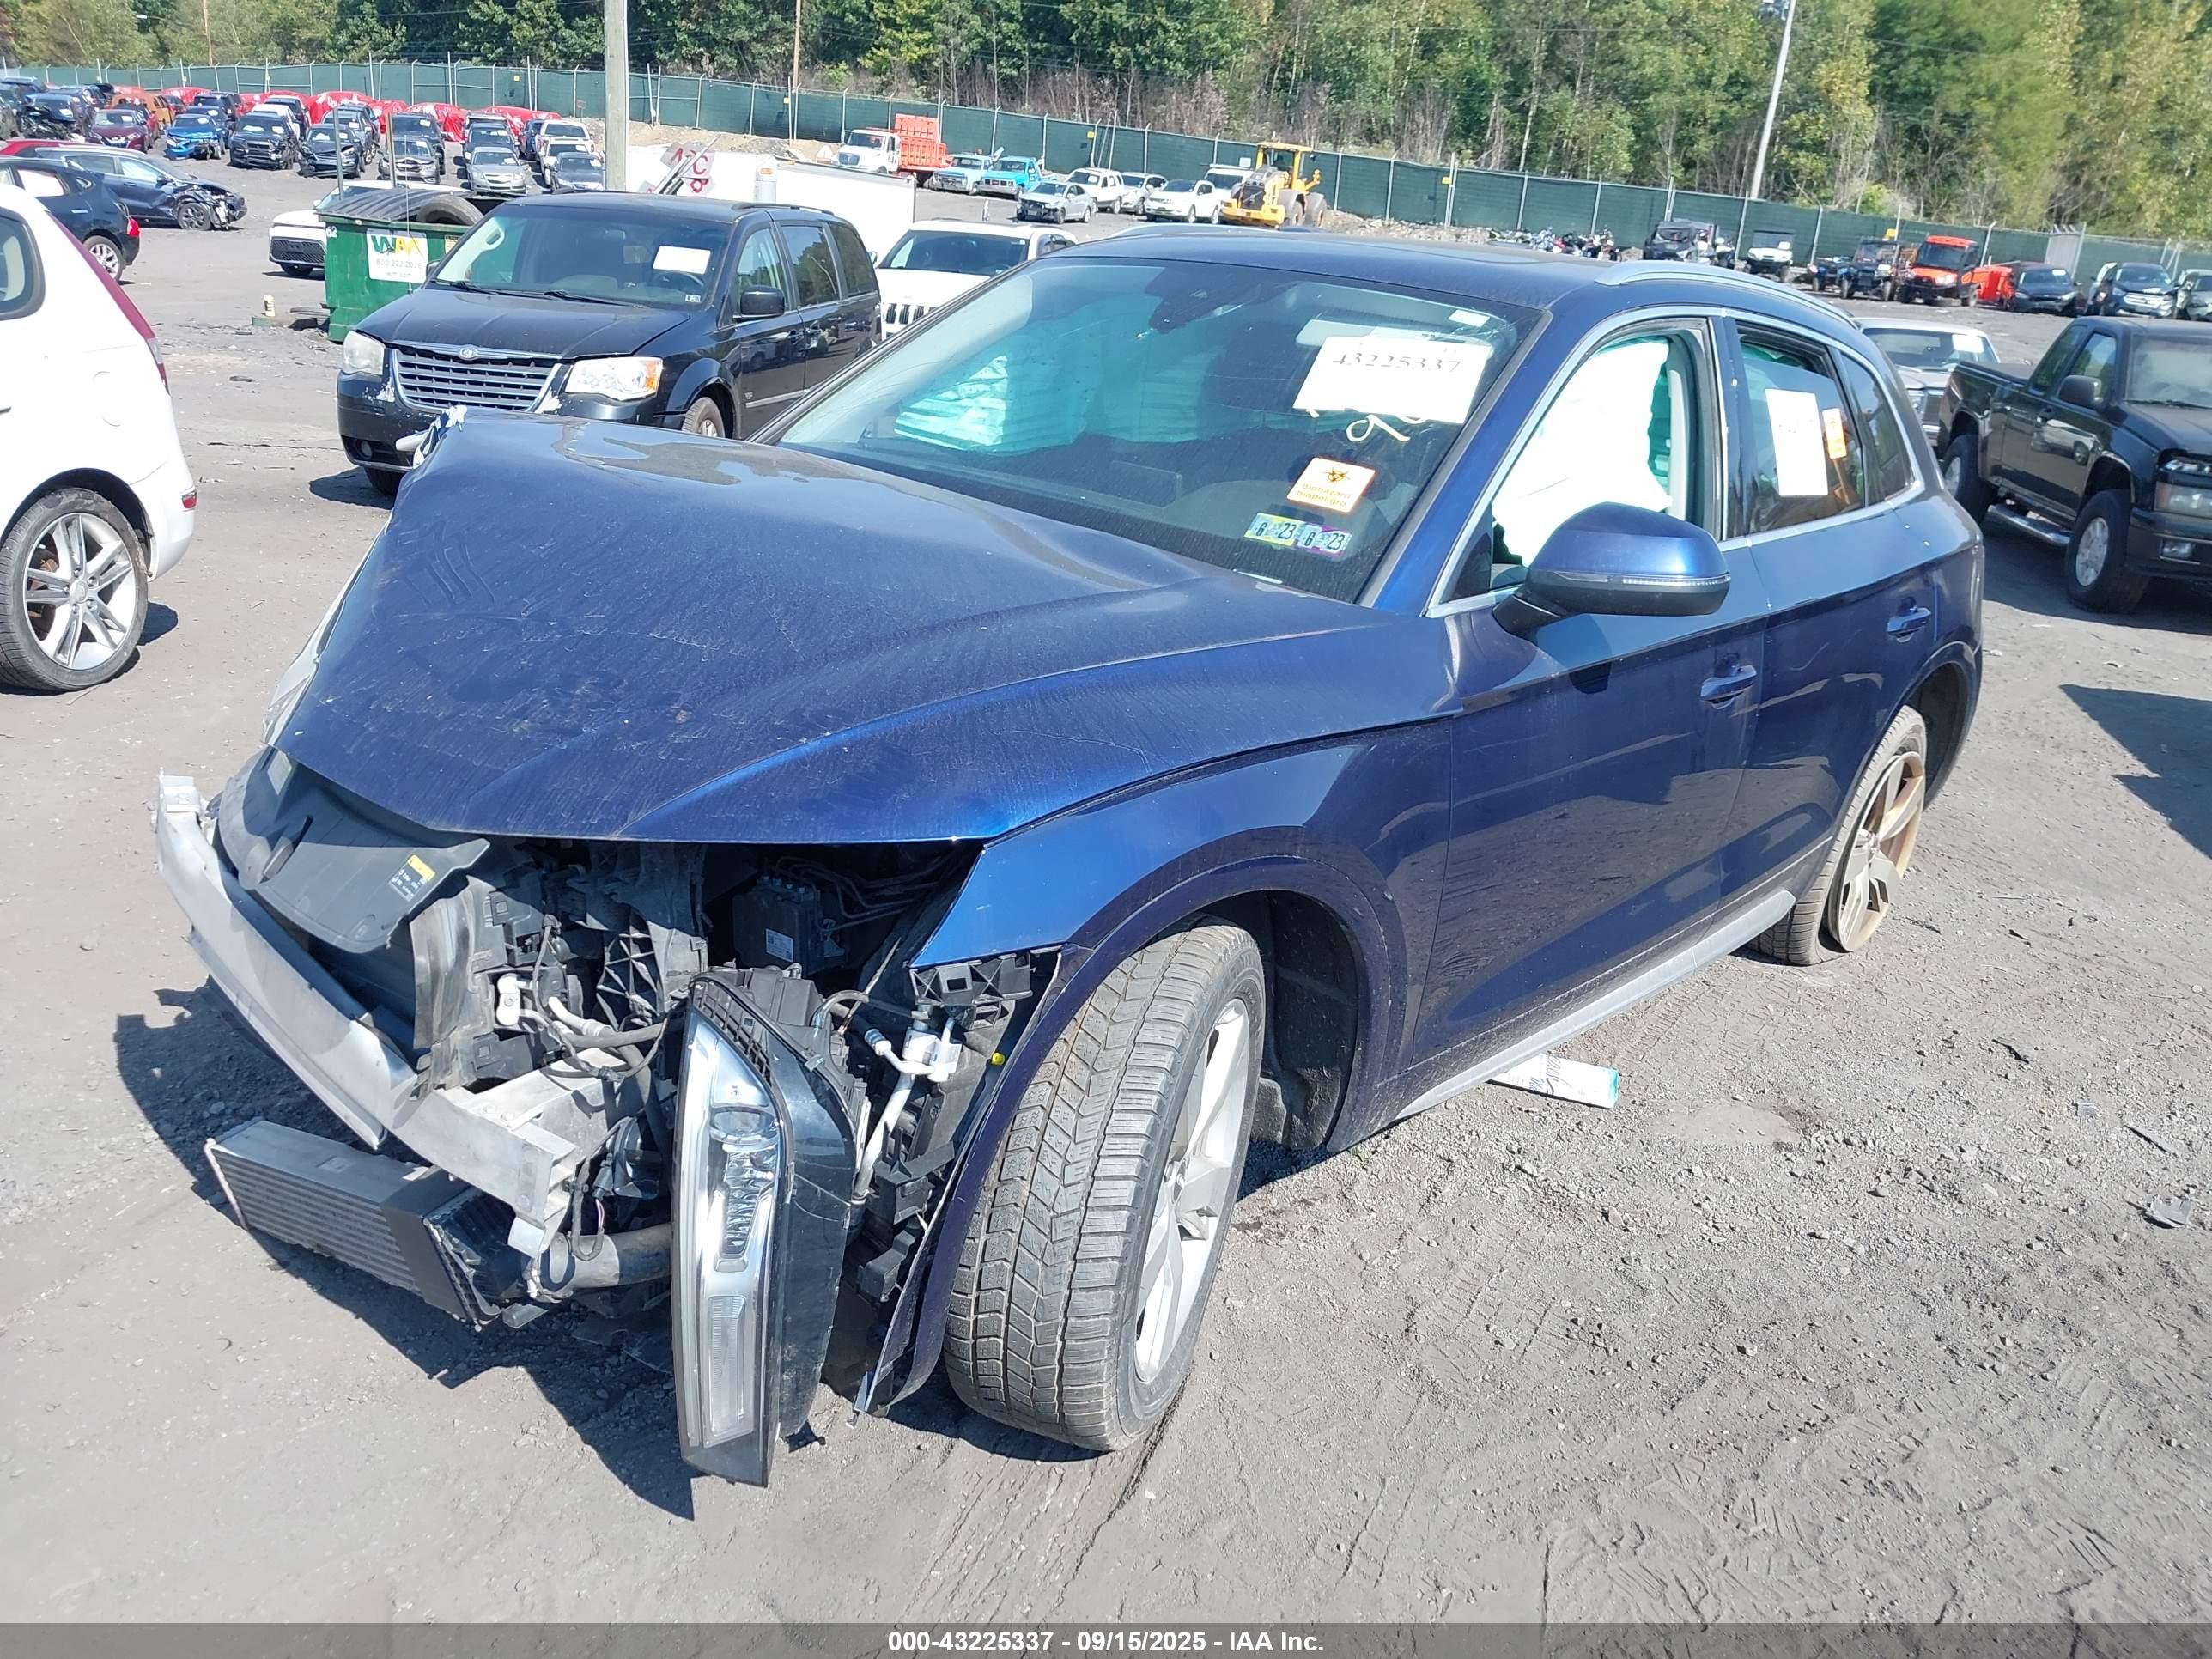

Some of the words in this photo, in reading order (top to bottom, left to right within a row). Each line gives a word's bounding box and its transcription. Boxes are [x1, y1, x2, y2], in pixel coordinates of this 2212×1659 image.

[1333, 352, 1462, 372] 43225337
[1256, 522, 1267, 537] 6
[1278, 522, 1297, 539] 23
[1305, 532, 1316, 546] 6
[1327, 532, 1346, 550] 23
